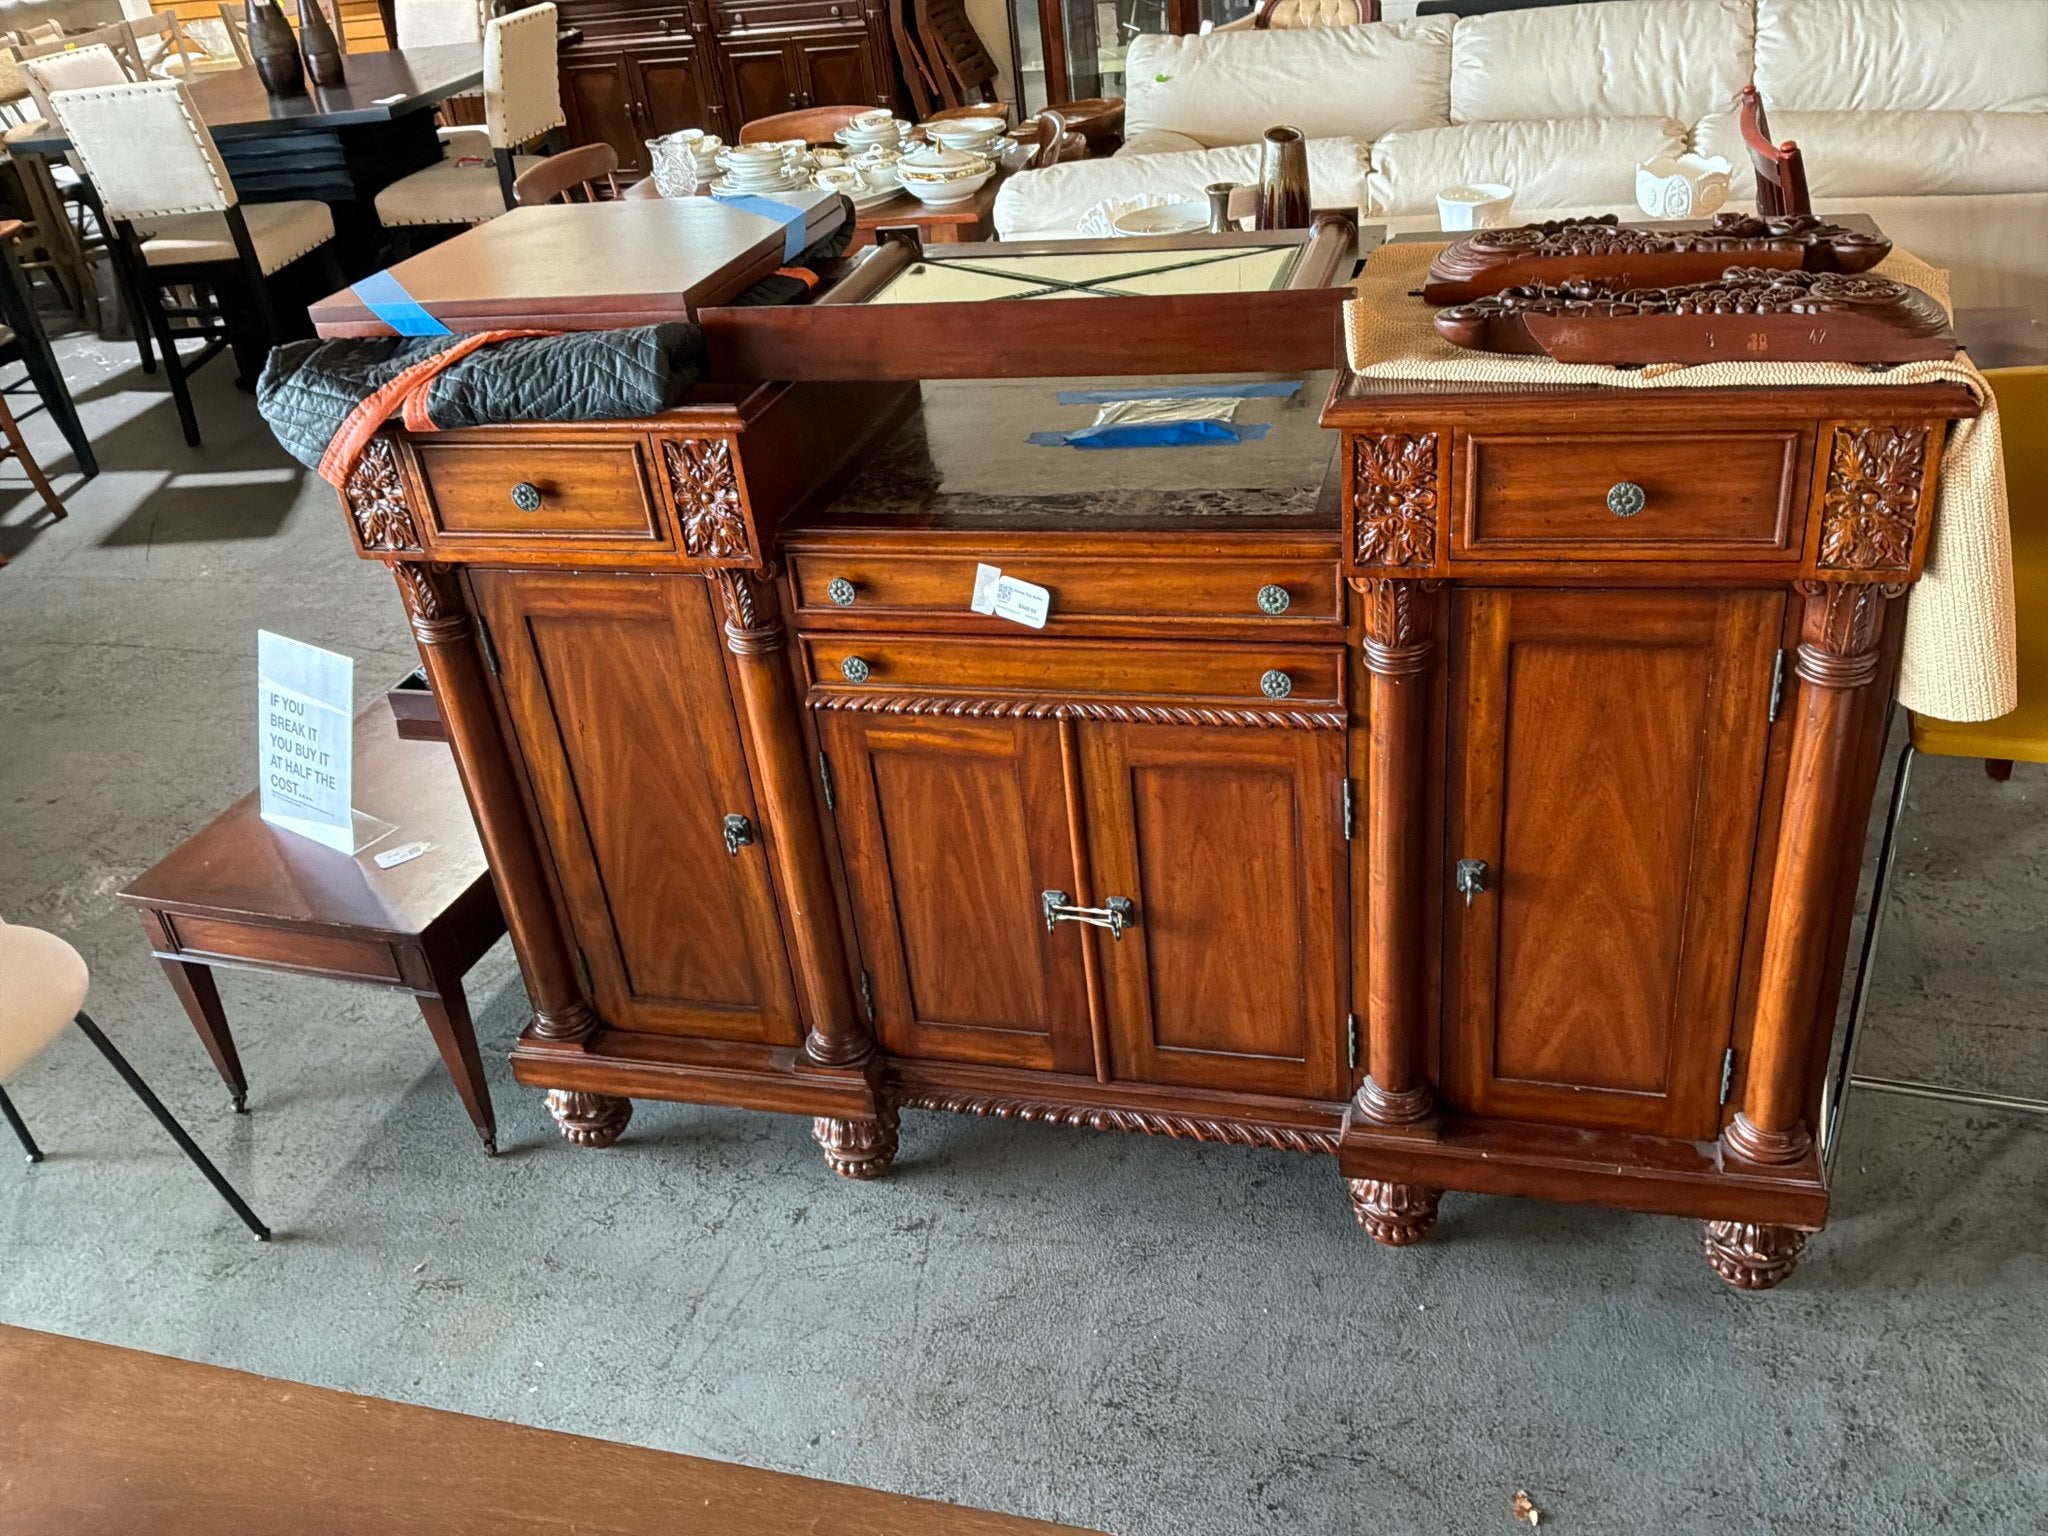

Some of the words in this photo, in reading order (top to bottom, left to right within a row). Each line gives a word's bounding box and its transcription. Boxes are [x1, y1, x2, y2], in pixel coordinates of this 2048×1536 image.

[270, 693, 280, 708] IF
[281, 697, 304, 716] YOU
[270, 713, 306, 738] BREAK
[308, 726, 318, 742] IT
[270, 733, 292, 753] YOU
[295, 743, 316, 761] BUY
[320, 751, 330, 766] IT
[270, 754, 283, 769] AT
[285, 759, 312, 780] HALF
[314, 770, 336, 790] THE
